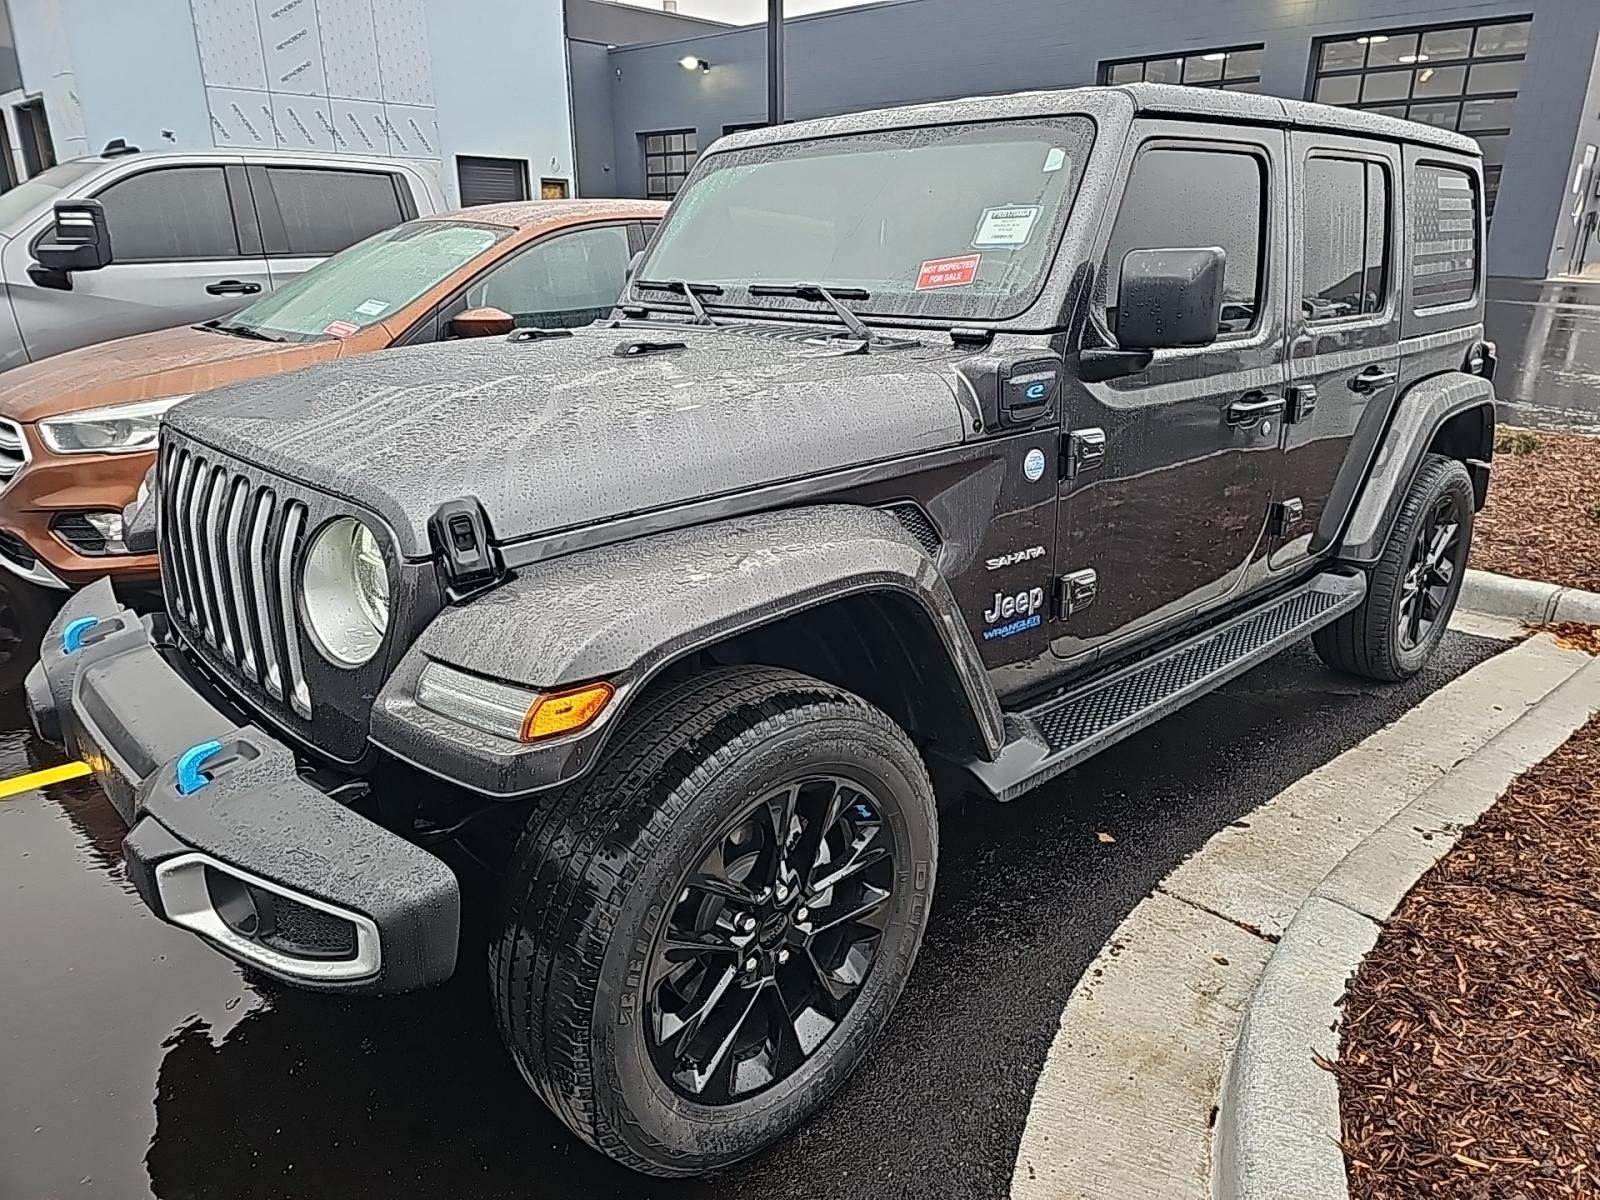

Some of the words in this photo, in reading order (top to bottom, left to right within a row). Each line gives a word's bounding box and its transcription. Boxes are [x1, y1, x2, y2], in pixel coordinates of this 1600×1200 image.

[923, 264, 938, 274] NOT
[937, 259, 976, 272] INSPECTED
[929, 274, 943, 284] FOR
[944, 271, 963, 282] SALE
[985, 545, 1046, 571] SAHARA
[984, 587, 1044, 623] Jeep
[983, 614, 1041, 640] WRANGLER
